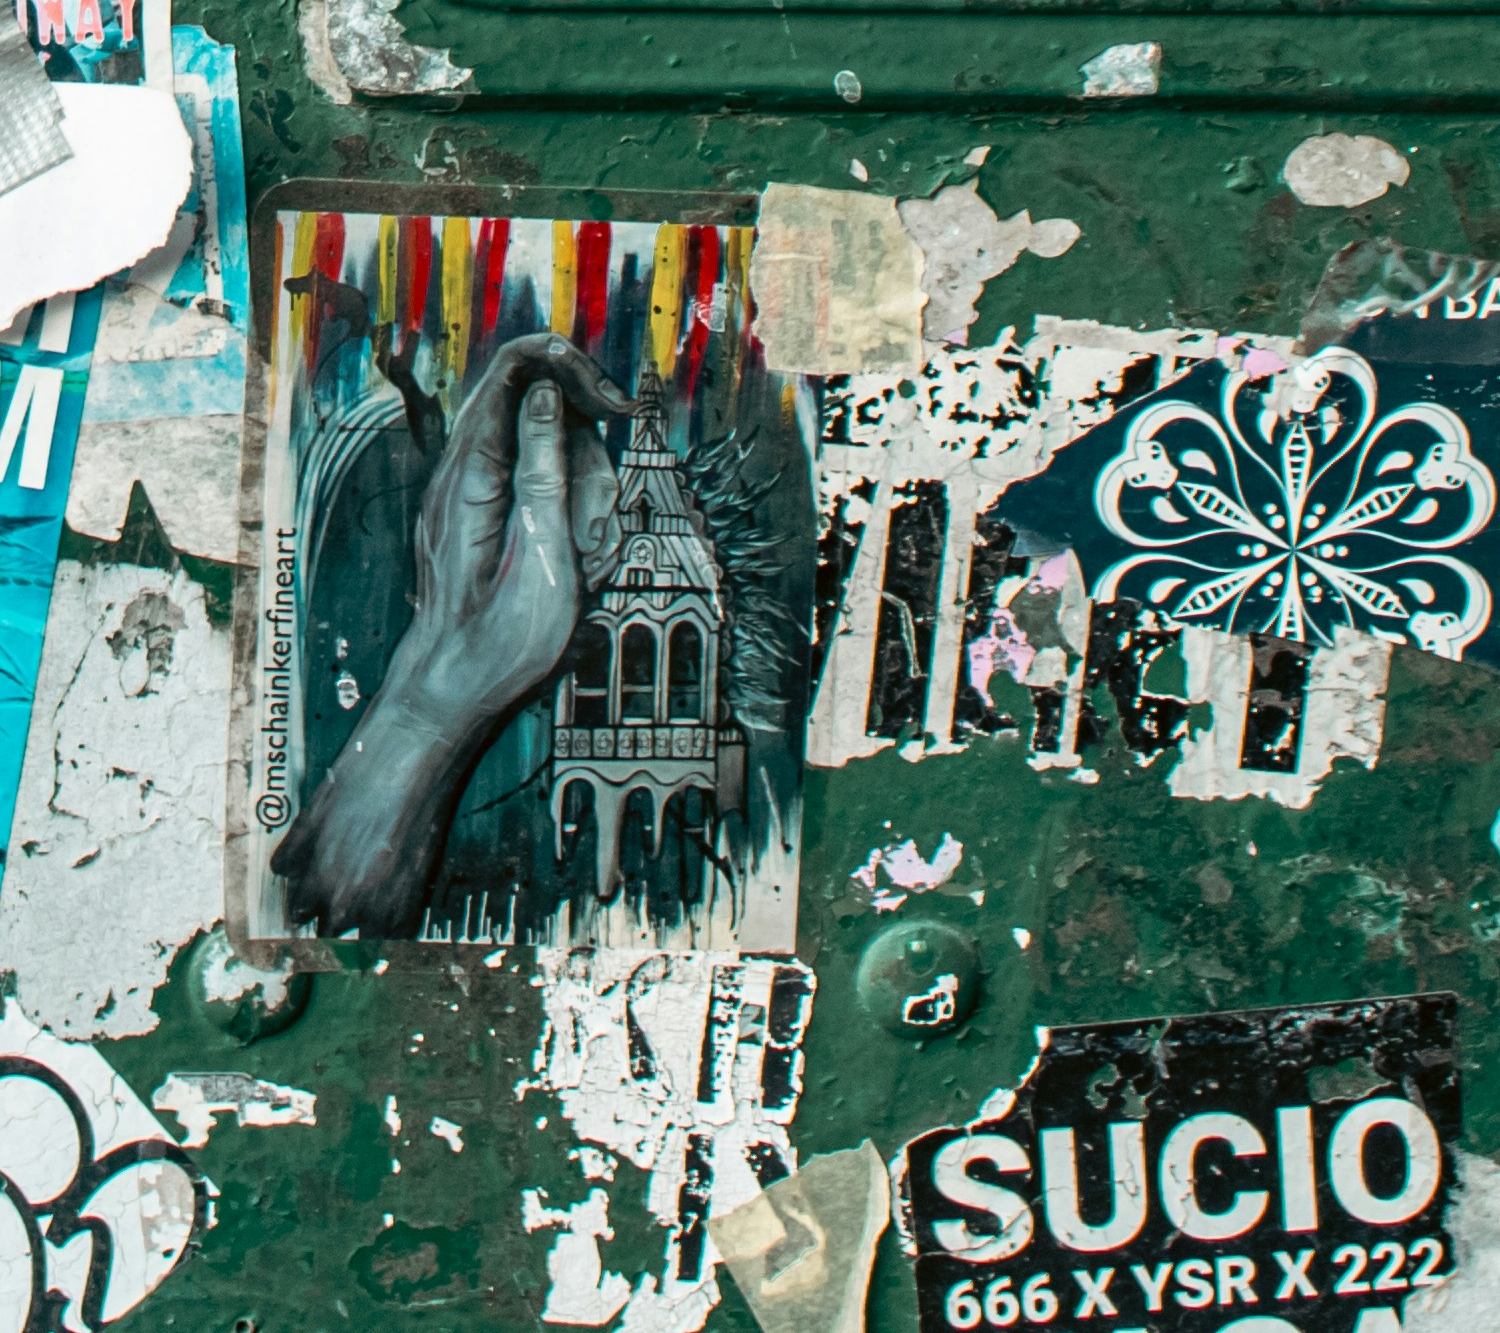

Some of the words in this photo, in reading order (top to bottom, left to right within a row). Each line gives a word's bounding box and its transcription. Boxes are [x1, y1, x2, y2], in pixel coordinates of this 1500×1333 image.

[931, 1098, 1441, 1263] SUCIO
[944, 1272, 1059, 1330] 666
[1074, 1268, 1118, 1320] X
[1132, 1254, 1259, 1312] YSR
[1275, 1248, 1319, 1301] X
[1333, 1237, 1447, 1295] 222
